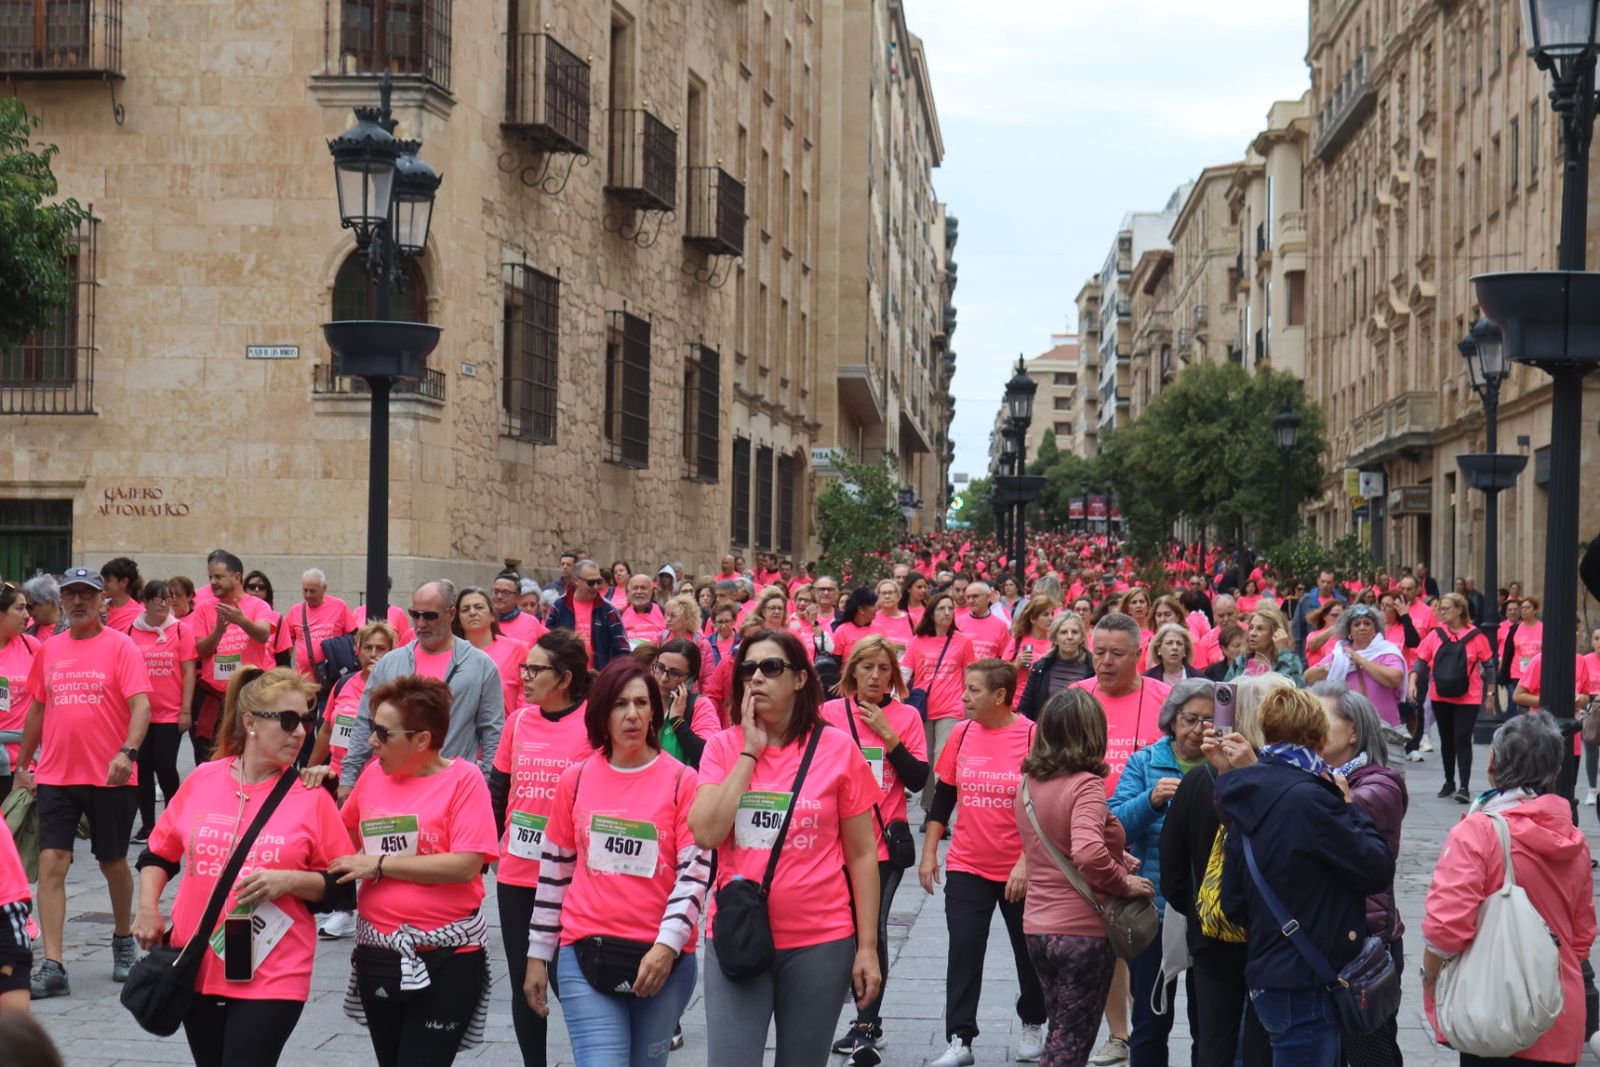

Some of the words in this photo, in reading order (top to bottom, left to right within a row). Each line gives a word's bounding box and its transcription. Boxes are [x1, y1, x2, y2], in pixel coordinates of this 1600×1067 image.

[104, 486, 163, 501] CAJERO
[53, 672, 64, 680] En
[66, 670, 105, 680] marcha
[52, 681, 90, 692] contra
[90, 681, 103, 692] el
[54, 691, 105, 705] cáncer
[518, 754, 530, 765] En
[516, 770, 560, 783] contra
[962, 767, 976, 778] En
[516, 782, 556, 800] cánc
[960, 781, 1006, 794] contra
[801, 813, 819, 829] el
[199, 826, 219, 839] En
[517, 827, 542, 845] 7674
[381, 834, 408, 853] 4511
[605, 836, 643, 857] 4507
[261, 848, 281, 863] el
